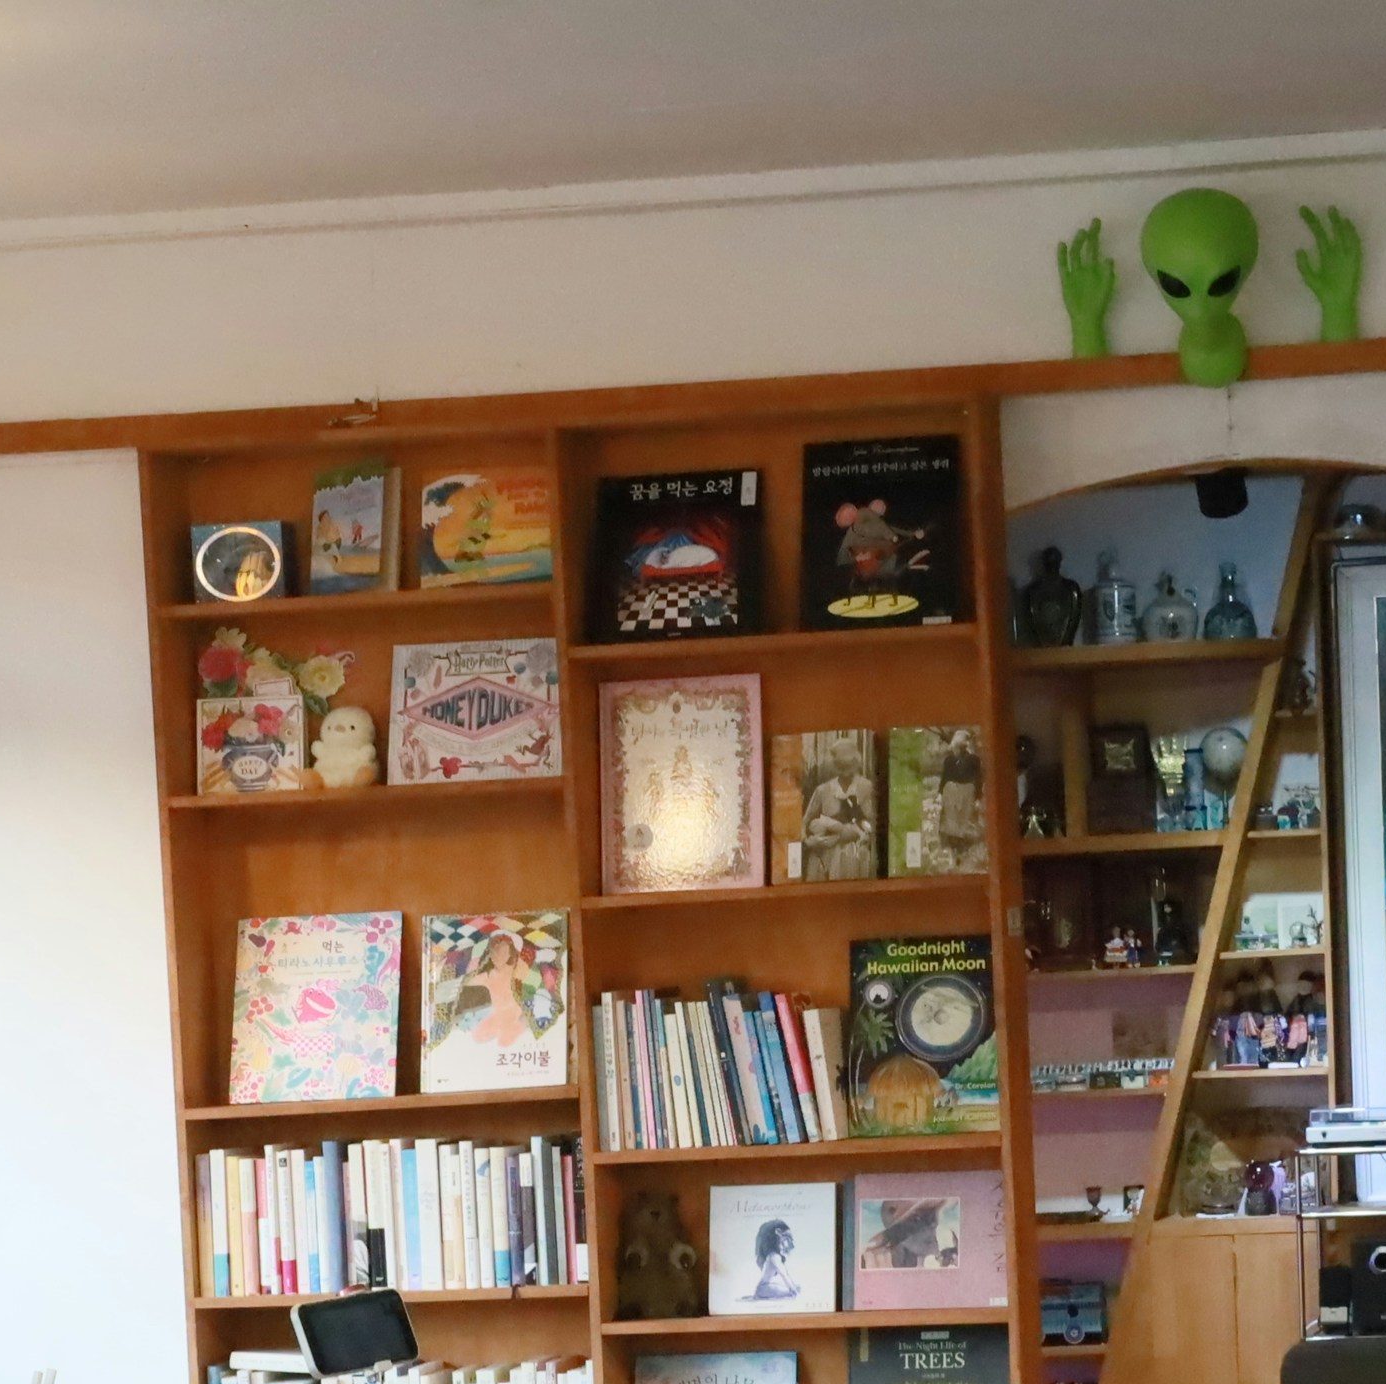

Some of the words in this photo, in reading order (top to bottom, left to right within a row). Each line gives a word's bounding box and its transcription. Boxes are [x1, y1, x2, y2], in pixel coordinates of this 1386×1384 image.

[629, 482, 662, 501] 꿈을
[666, 480, 698, 498] 먹는
[702, 476, 733, 495] 요정
[452, 650, 479, 674] Harry
[478, 652, 506, 669] Potter
[321, 939, 345, 954] 먹는
[886, 939, 966, 957] Goodnight
[867, 959, 939, 976] Hawaiian
[941, 957, 986, 972] Moon
[496, 1049, 551, 1069] 조각이불
[898, 1351, 966, 1370] TREES
